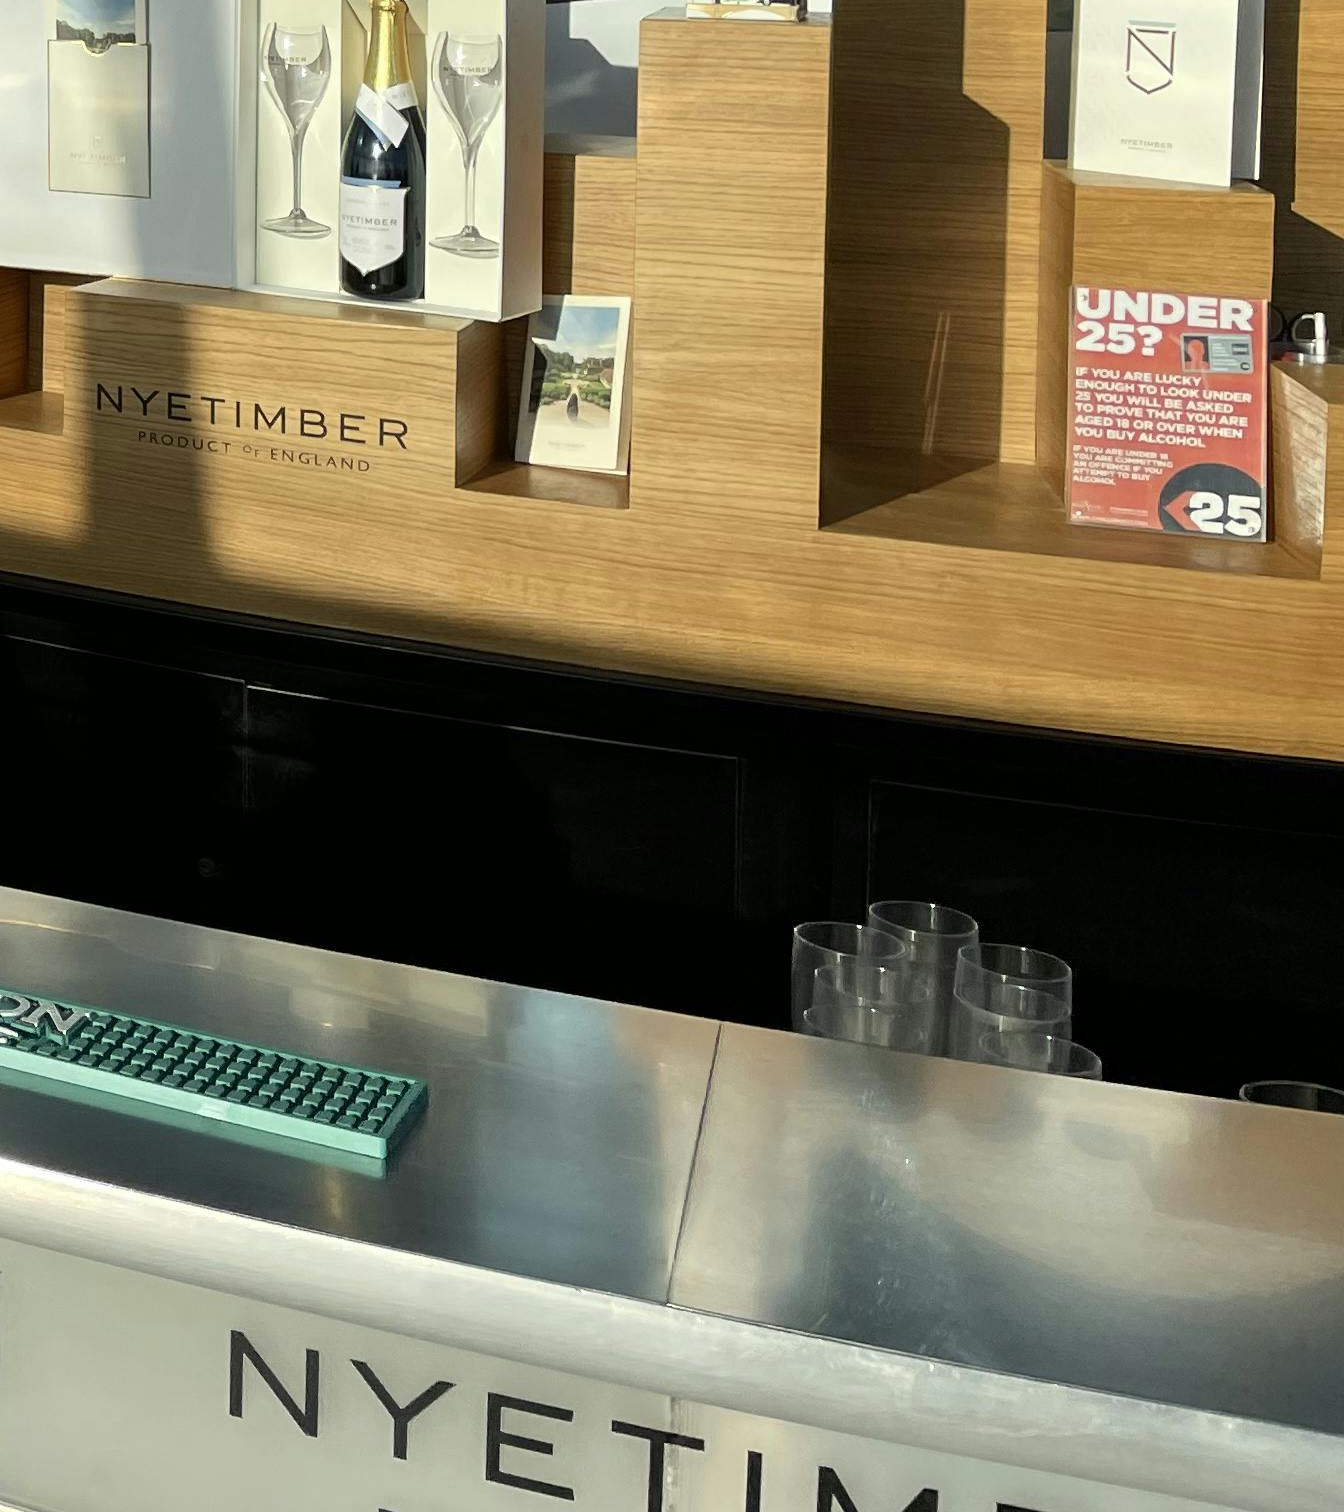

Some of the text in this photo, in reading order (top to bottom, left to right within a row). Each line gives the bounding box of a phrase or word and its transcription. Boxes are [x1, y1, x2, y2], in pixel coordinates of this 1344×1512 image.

[1075, 287, 1254, 332] UNDER
[1075, 320, 1163, 357] 25?
[1075, 367, 1202, 387] IF YOU ARE LUCKY
[1075, 378, 1252, 404] ENOUGH TO LOOK UNDER
[1094, 392, 1123, 404] YOU
[1127, 396, 1161, 408] WILL
[1164, 399, 1183, 409] BE
[1186, 400, 1233, 414] ASKED
[95, 383, 410, 451] NYETIMBER
[1074, 403, 1248, 427] TO PROVE THAT YOU ARE
[1074, 415, 1243, 439] AGED 18 OR OVER WHEN
[1074, 426, 1206, 448] YOU BUY ALCOHOL
[137, 430, 232, 455] PRODUCT
[269, 447, 371, 473] ENGLAND
[1189, 491, 1262, 537] 25
